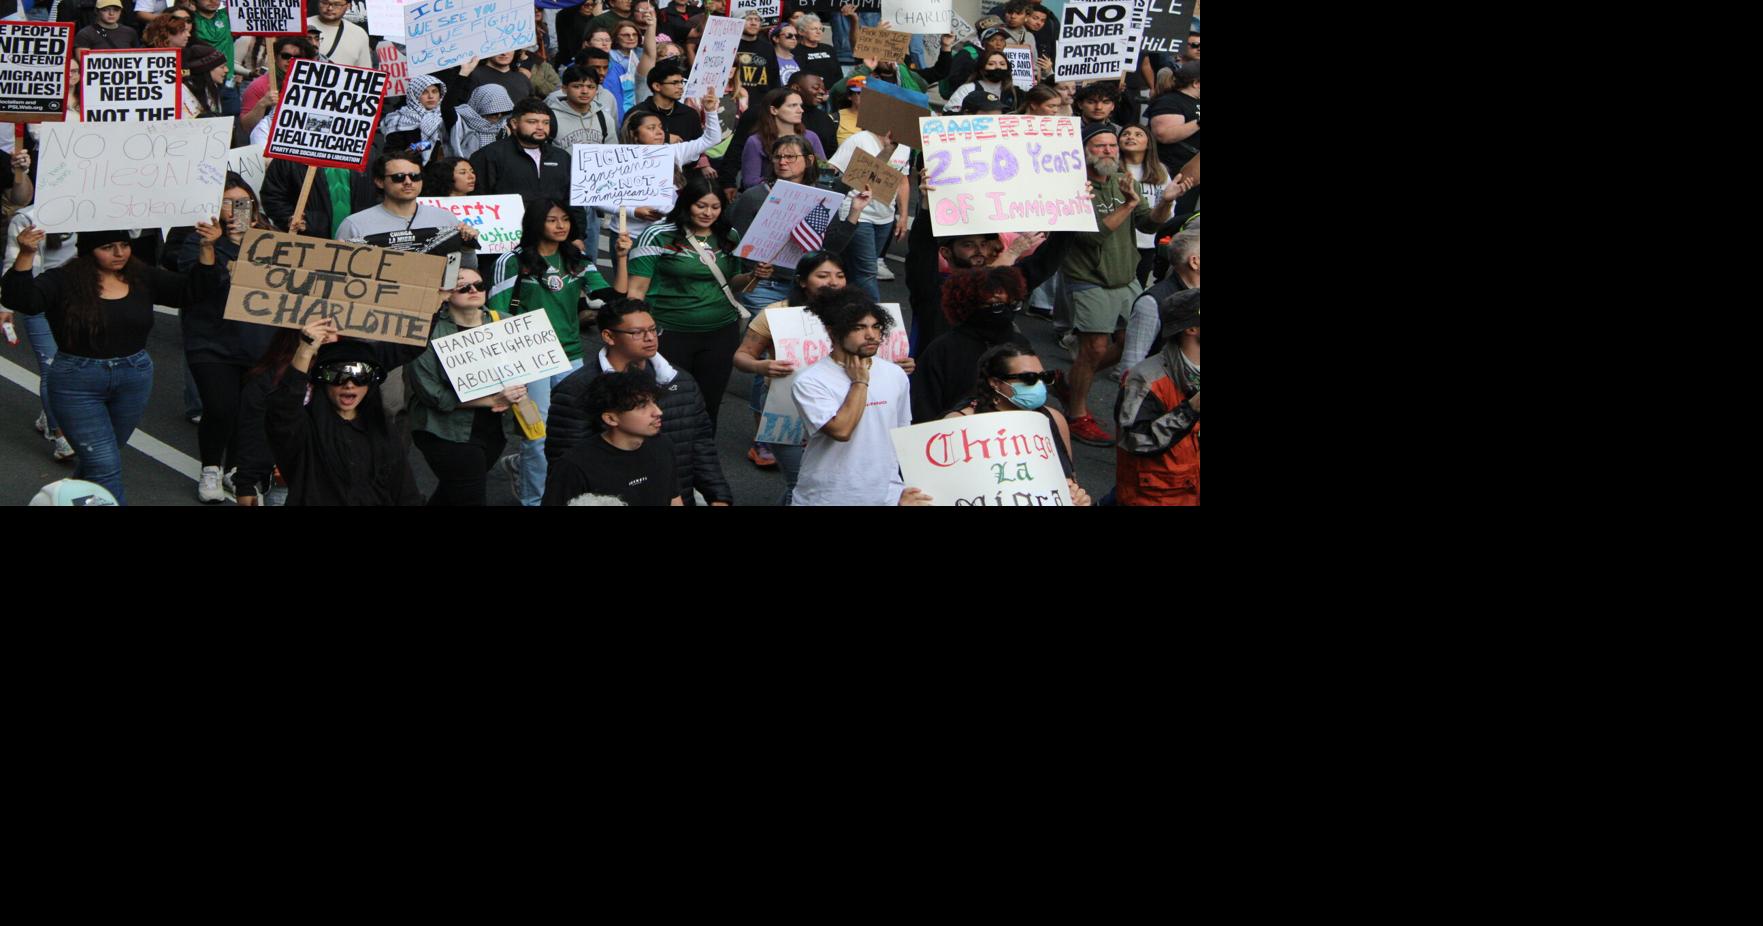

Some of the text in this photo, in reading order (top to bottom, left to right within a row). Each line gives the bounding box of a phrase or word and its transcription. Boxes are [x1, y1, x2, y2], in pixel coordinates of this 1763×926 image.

[410, 0, 454, 20] ICE
[738, 0, 757, 8] HAS
[238, 7, 294, 20] A GENERAL
[1064, 4, 1127, 26] NO
[11, 25, 67, 38] PEOPLE
[246, 19, 287, 32] STRIKE!
[408, 21, 432, 38] WE
[438, 11, 467, 28] SEE
[1063, 23, 1124, 39] BORDER
[377, 46, 398, 63] NO
[1018, 52, 1030, 61] FOR
[1063, 42, 1118, 58] PATROL
[12, 55, 64, 66] DEFEND
[87, 56, 177, 70] MONEY FOR
[1016, 60, 1031, 69] AND
[1057, 60, 1121, 77] CHARLOTTE!
[86, 69, 177, 86] PEOPLE'S
[291, 60, 386, 95] END THE
[380, 61, 408, 79] BO
[100, 85, 163, 102] NEEDS
[284, 84, 380, 118] ATTACKS
[86, 108, 130, 123] NOT
[278, 109, 371, 140] ON OUR
[922, 116, 1075, 145] AMERICA
[273, 127, 367, 155] HEALTHCARE!
[288, 148, 300, 156] FOR
[299, 149, 327, 159] SOCIALISM
[332, 154, 361, 164] LIBERATION
[578, 146, 640, 171] FIGHT
[925, 143, 1020, 186] 250
[1025, 142, 1083, 174] Years
[618, 175, 656, 189] NOT
[579, 187, 660, 205] immigrants
[462, 215, 484, 227] nd
[479, 226, 523, 243] ustice
[246, 232, 404, 284] GET ICE
[265, 267, 401, 304] OUT OF
[242, 290, 430, 341] CHARLOTTE
[437, 315, 532, 354] HANDS OFF
[446, 329, 557, 369] OUR NEIGHBORS
[457, 349, 561, 392] ABOLISH ICE
[925, 427, 1057, 468] Chinga
[990, 461, 1034, 485] La
